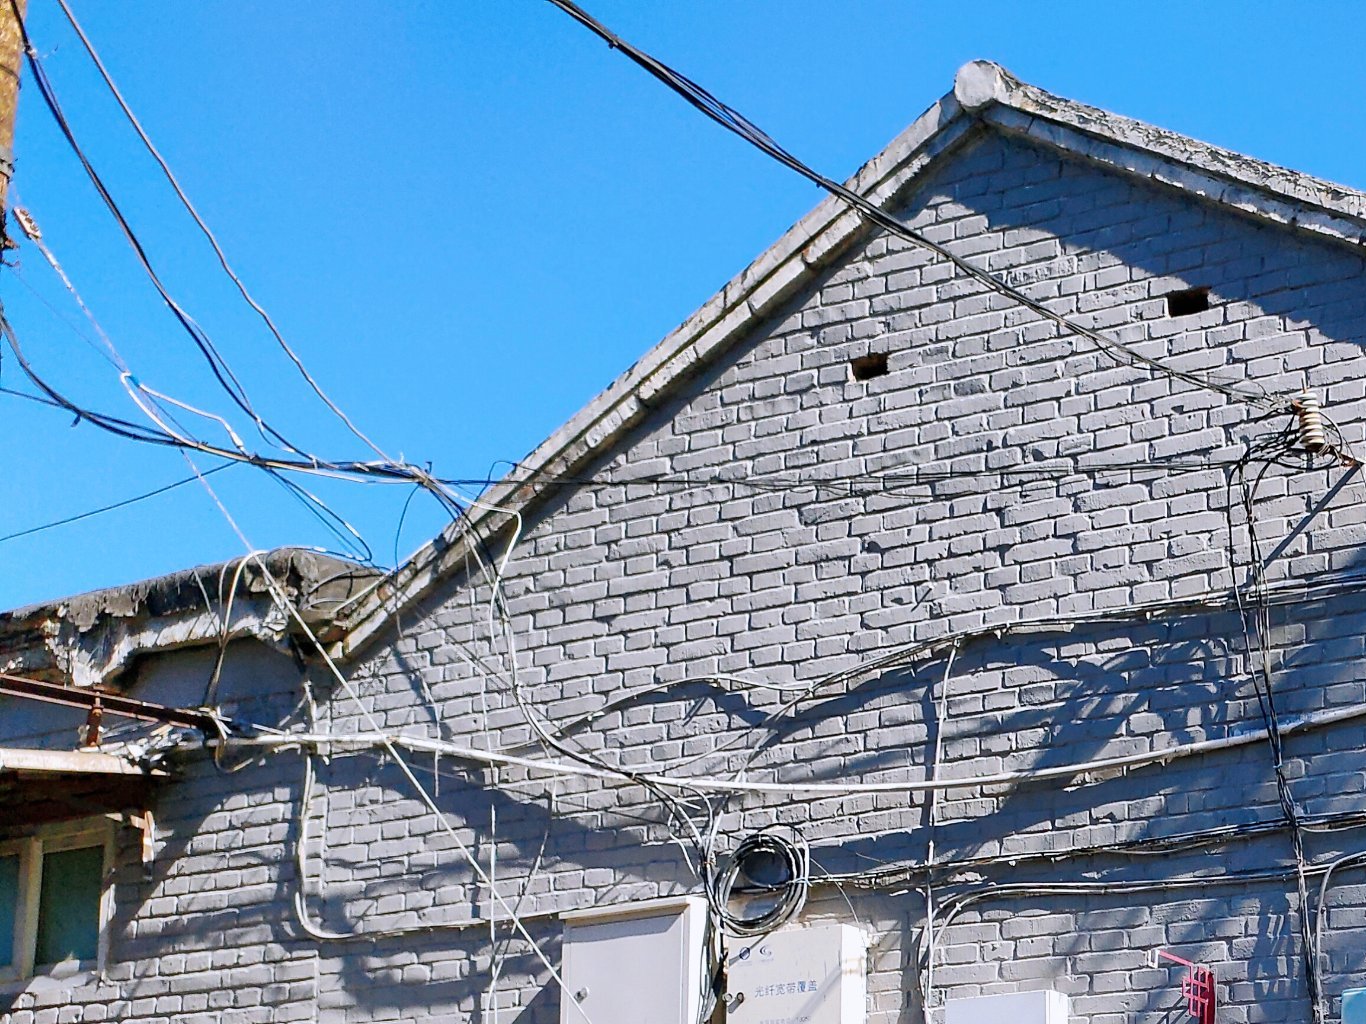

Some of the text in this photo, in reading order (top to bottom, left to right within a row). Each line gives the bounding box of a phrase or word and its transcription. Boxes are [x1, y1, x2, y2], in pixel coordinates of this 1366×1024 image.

[754, 980, 818, 999] 光纤宽带覆盖
